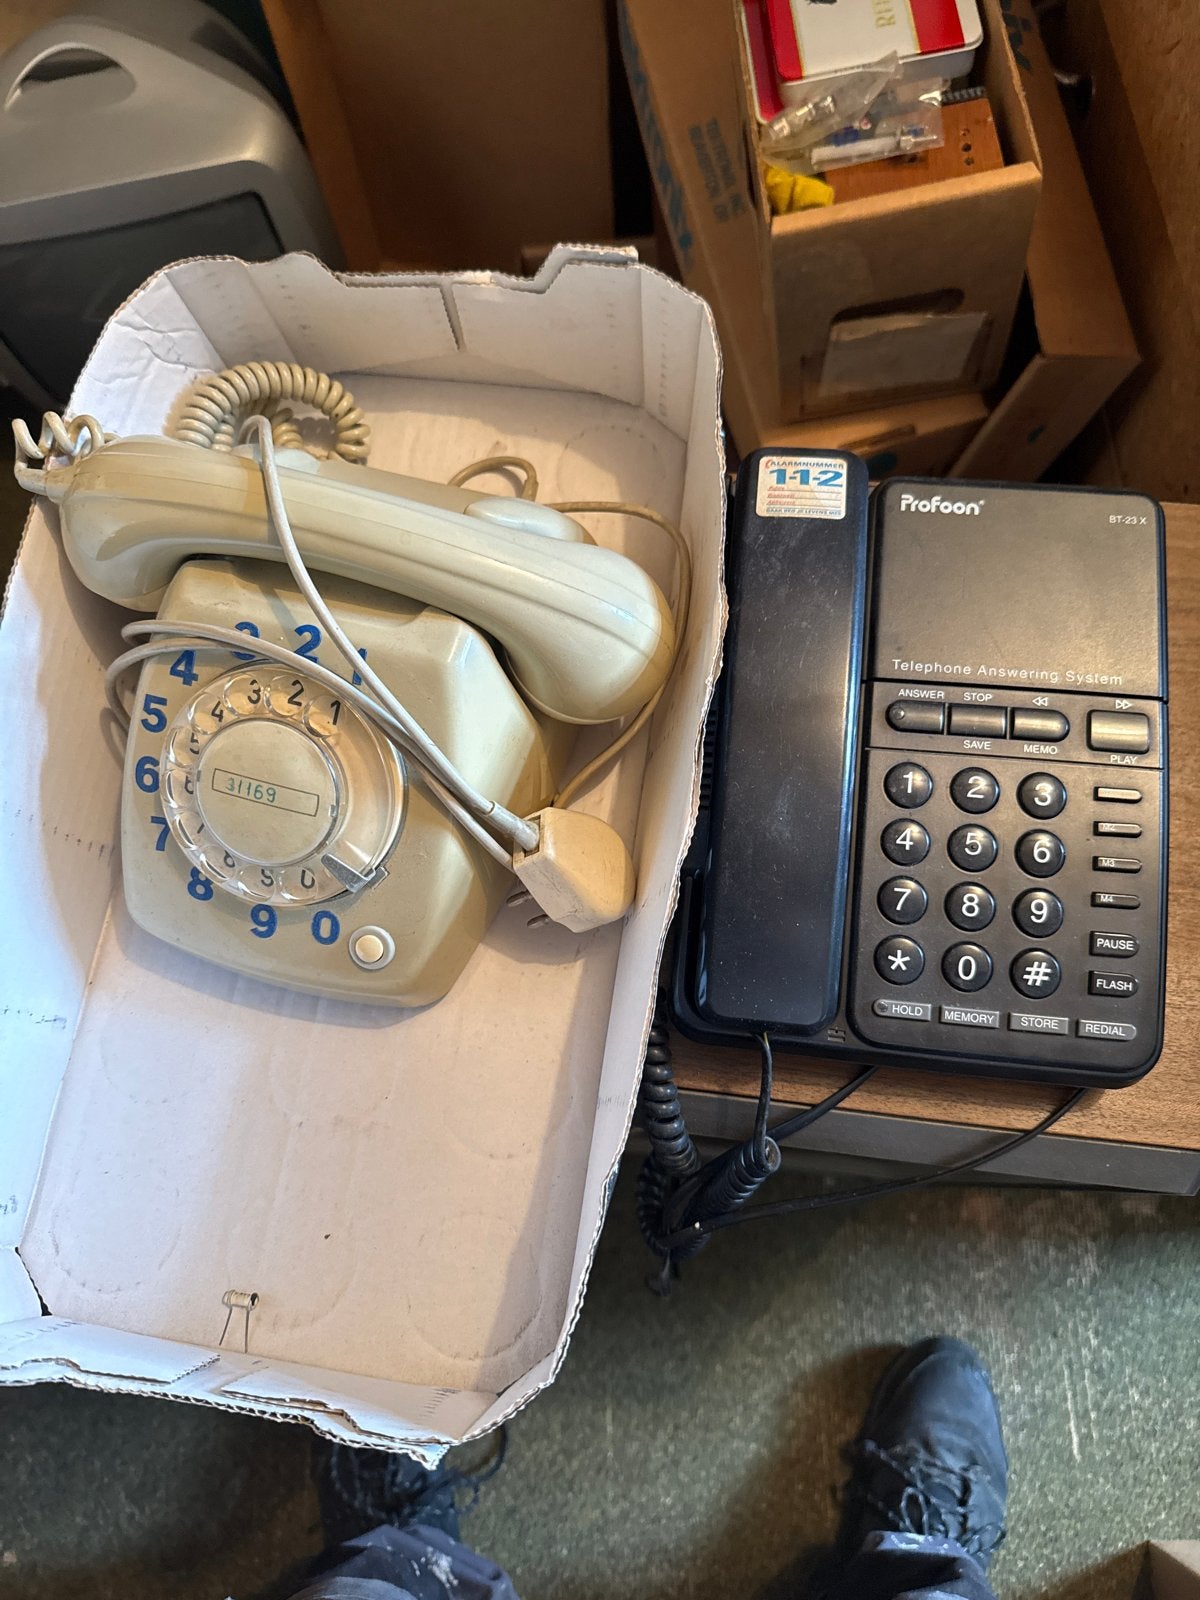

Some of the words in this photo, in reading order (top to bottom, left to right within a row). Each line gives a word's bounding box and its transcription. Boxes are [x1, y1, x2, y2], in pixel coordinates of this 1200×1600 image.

[769, 468, 843, 487] 1-1-2
[900, 494, 980, 515] Profoon
[1109, 515, 1137, 525] BT-23
[1139, 516, 1147, 525] X
[294, 624, 322, 663] 2
[169, 650, 199, 686] 4
[892, 659, 972, 675] Telephone
[977, 664, 1059, 683] Answering
[1065, 670, 1123, 686] System
[247, 679, 261, 705] 3
[287, 679, 305, 706] 2
[898, 688, 945, 699] ANSWER
[963, 692, 992, 702] STOP
[140, 693, 168, 734] 5
[211, 700, 224, 723] 4
[330, 699, 342, 725] 1
[963, 739, 991, 750] SAVE
[1023, 744, 1058, 755] MEMO
[1110, 755, 1138, 765] PLAY
[135, 756, 160, 793] 6
[902, 771, 913, 794] 1
[225, 777, 277, 803] 31169
[966, 776, 985, 799] 2
[1034, 782, 1051, 806] 3
[150, 815, 171, 852] 7
[896, 828, 914, 851] 4
[964, 833, 982, 855] 5
[1033, 840, 1051, 863] 6
[1102, 859, 1115, 867] M3
[187, 866, 214, 901] 8
[893, 888, 911, 911] 7
[961, 893, 979, 917] 8
[250, 903, 278, 939] 9
[1030, 900, 1048, 923] 9
[311, 910, 340, 945] 0
[1096, 938, 1134, 950] PAUSE
[957, 955, 976, 980] 0
[1096, 979, 1132, 991] FLASH
[892, 1004, 922, 1016] HOLD
[944, 1010, 995, 1024] MEMORY
[1020, 1017, 1059, 1029] STORE
[1085, 1024, 1126, 1037] REDIAL
